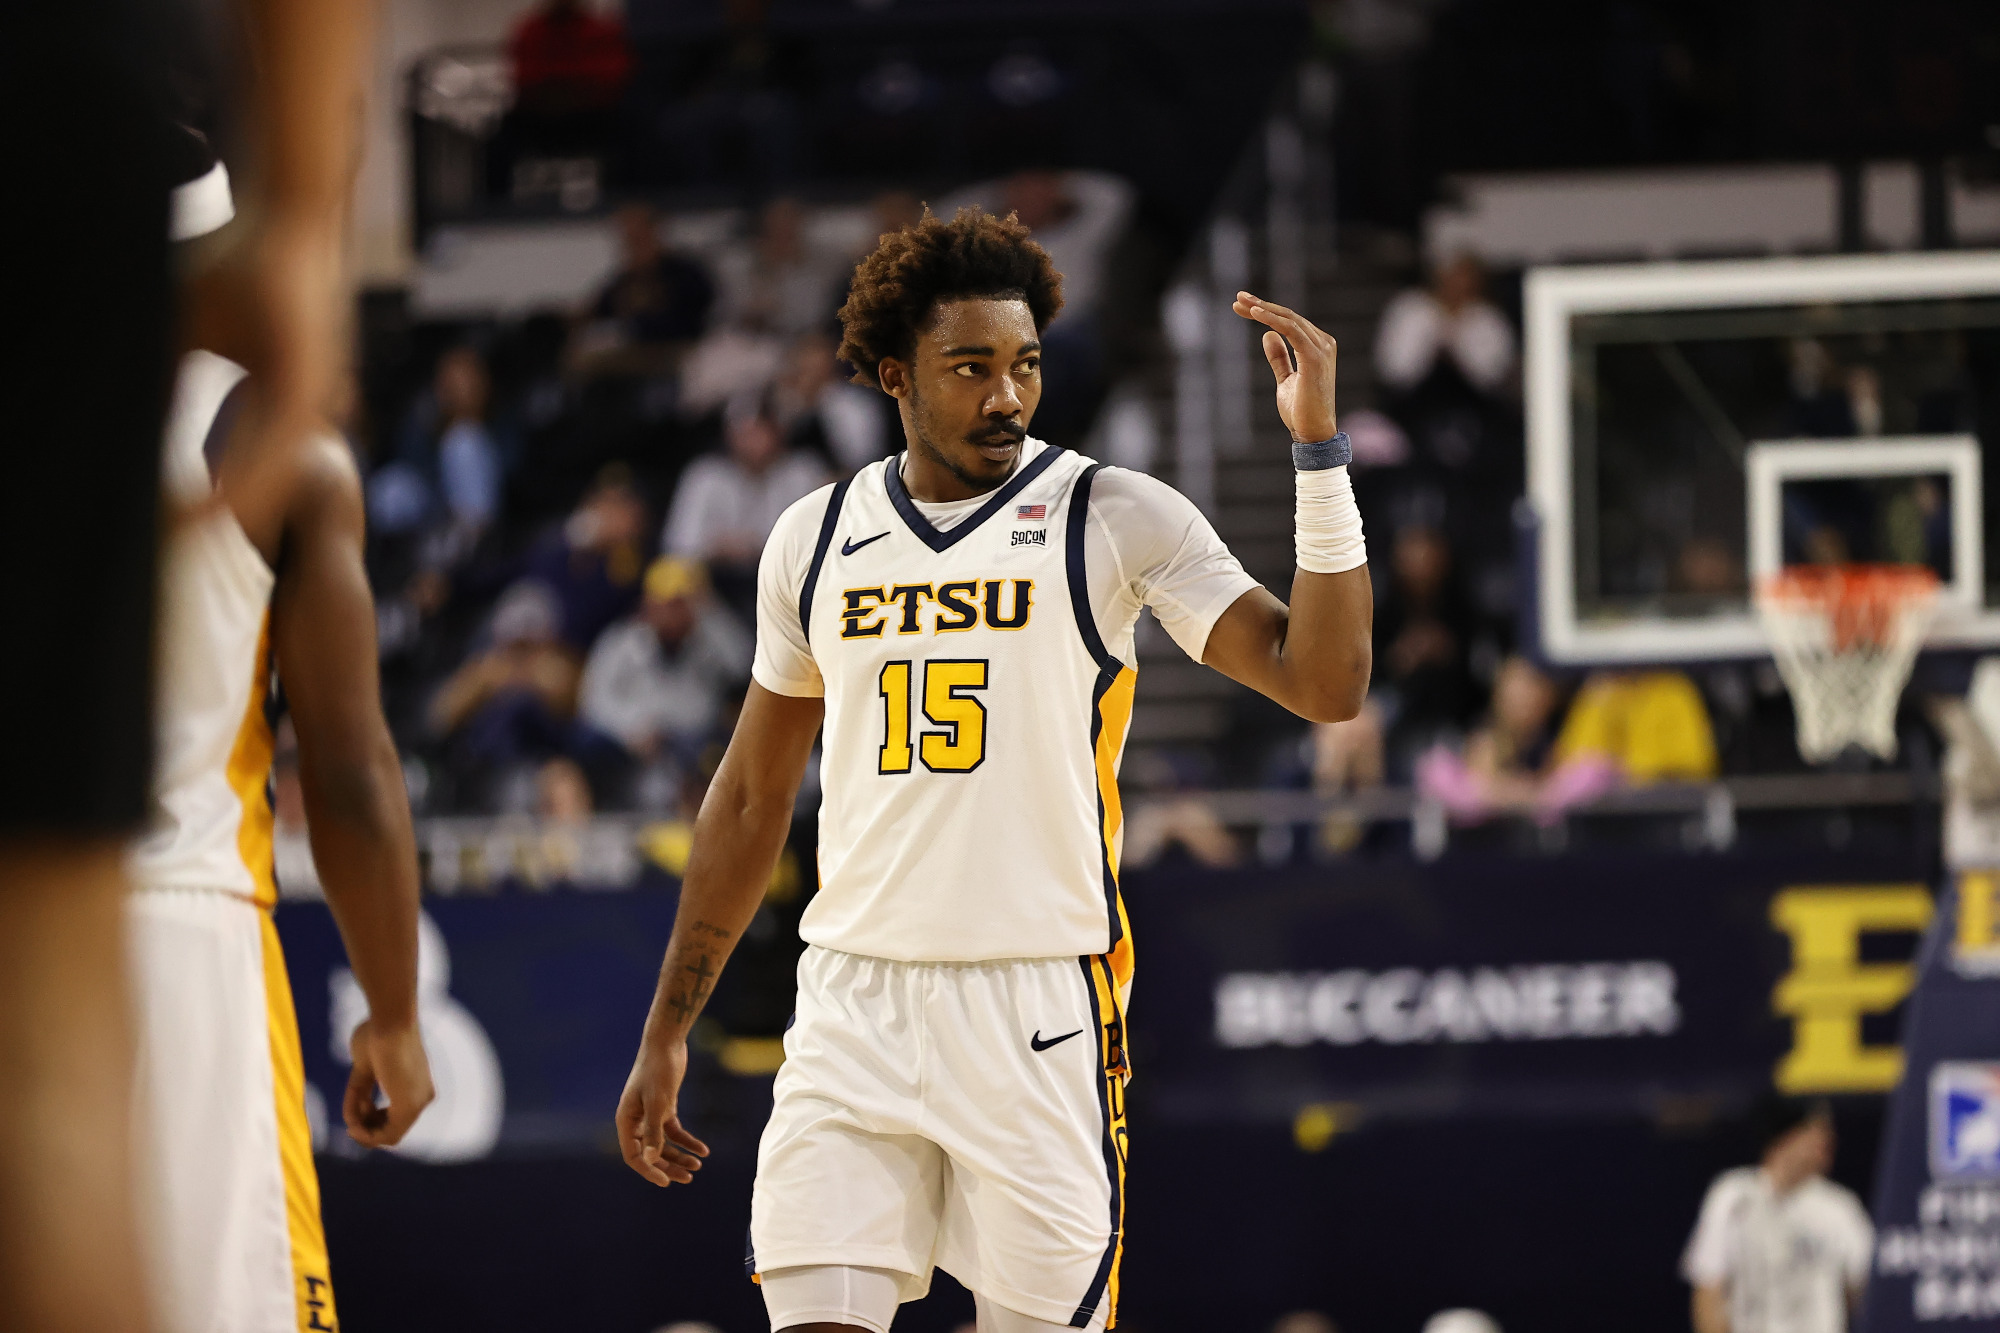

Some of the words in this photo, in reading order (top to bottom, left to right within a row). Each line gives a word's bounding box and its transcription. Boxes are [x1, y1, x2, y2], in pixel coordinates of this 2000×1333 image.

[840, 578, 1035, 640] ETSU
[878, 658, 989, 775] 15
[1216, 962, 1678, 1047] BUCCANEER
